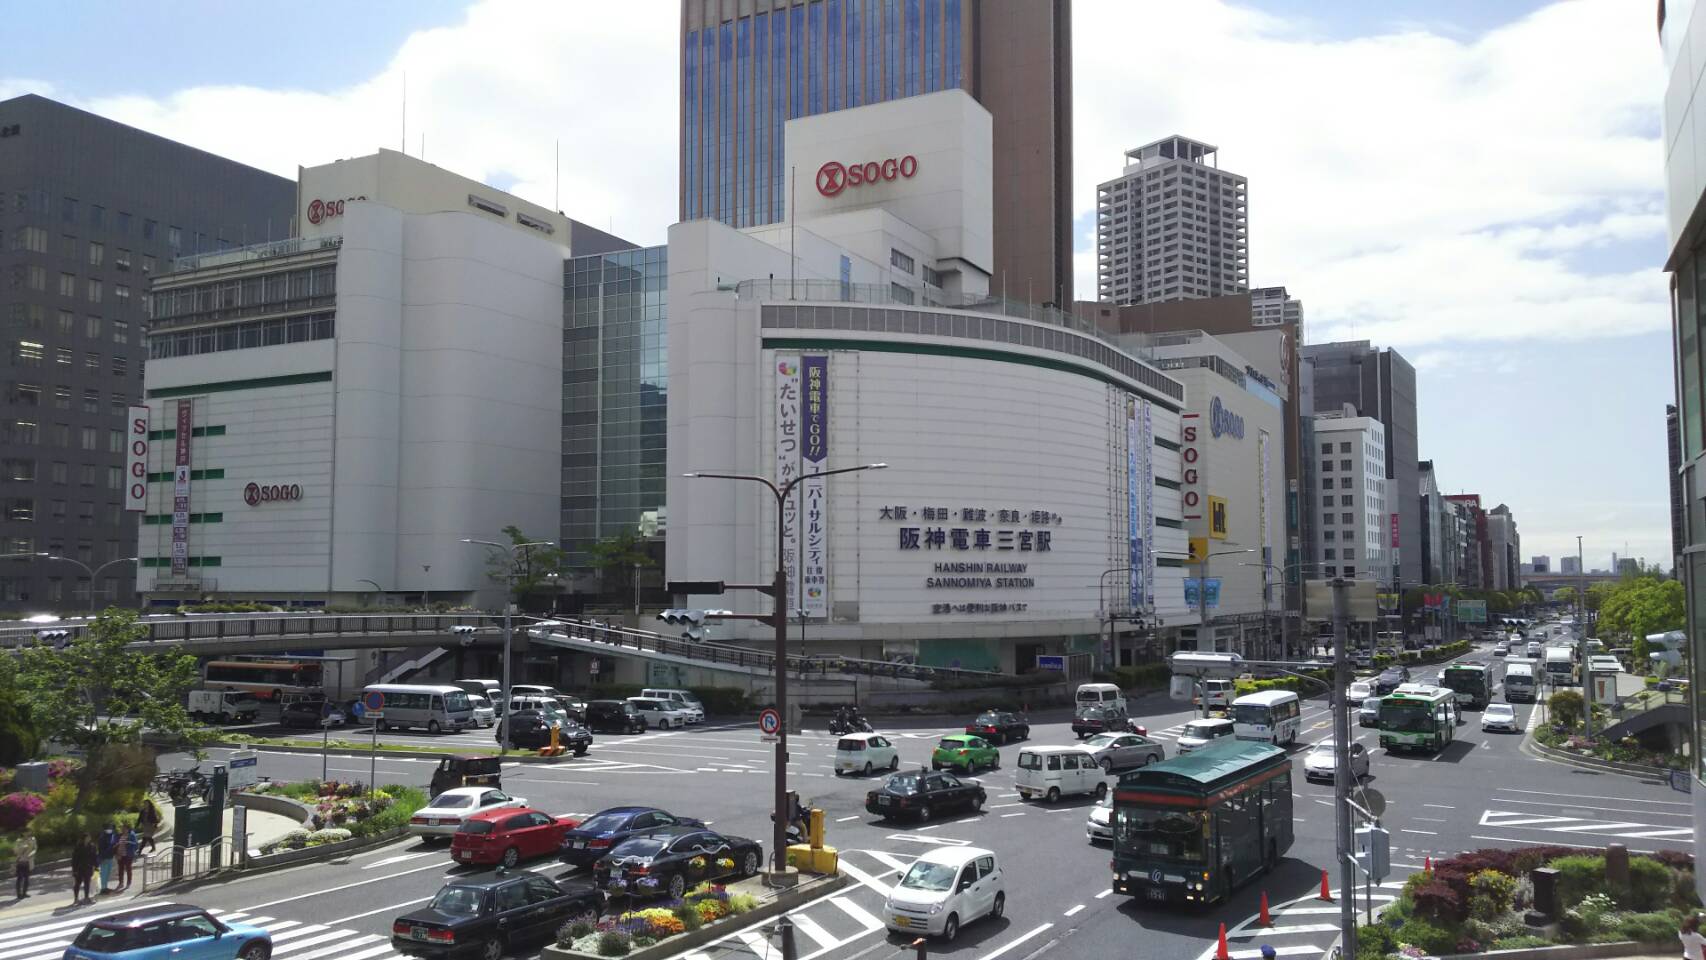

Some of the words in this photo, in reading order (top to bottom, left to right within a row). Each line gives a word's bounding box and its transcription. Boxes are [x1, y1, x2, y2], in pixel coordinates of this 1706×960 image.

[847, 155, 918, 186] SOGO
[326, 196, 367, 217] SO
[131, 418, 147, 499] SOGO
[1184, 427, 1199, 507] SOGO
[261, 483, 301, 501] SOGO
[899, 527, 1052, 552] 阪神電車三宮駅
[934, 562, 984, 574] HANSHIN
[986, 562, 1028, 574] RAILWAY
[926, 577, 993, 589] SANNOMIYA
[996, 577, 1035, 589] STATION
